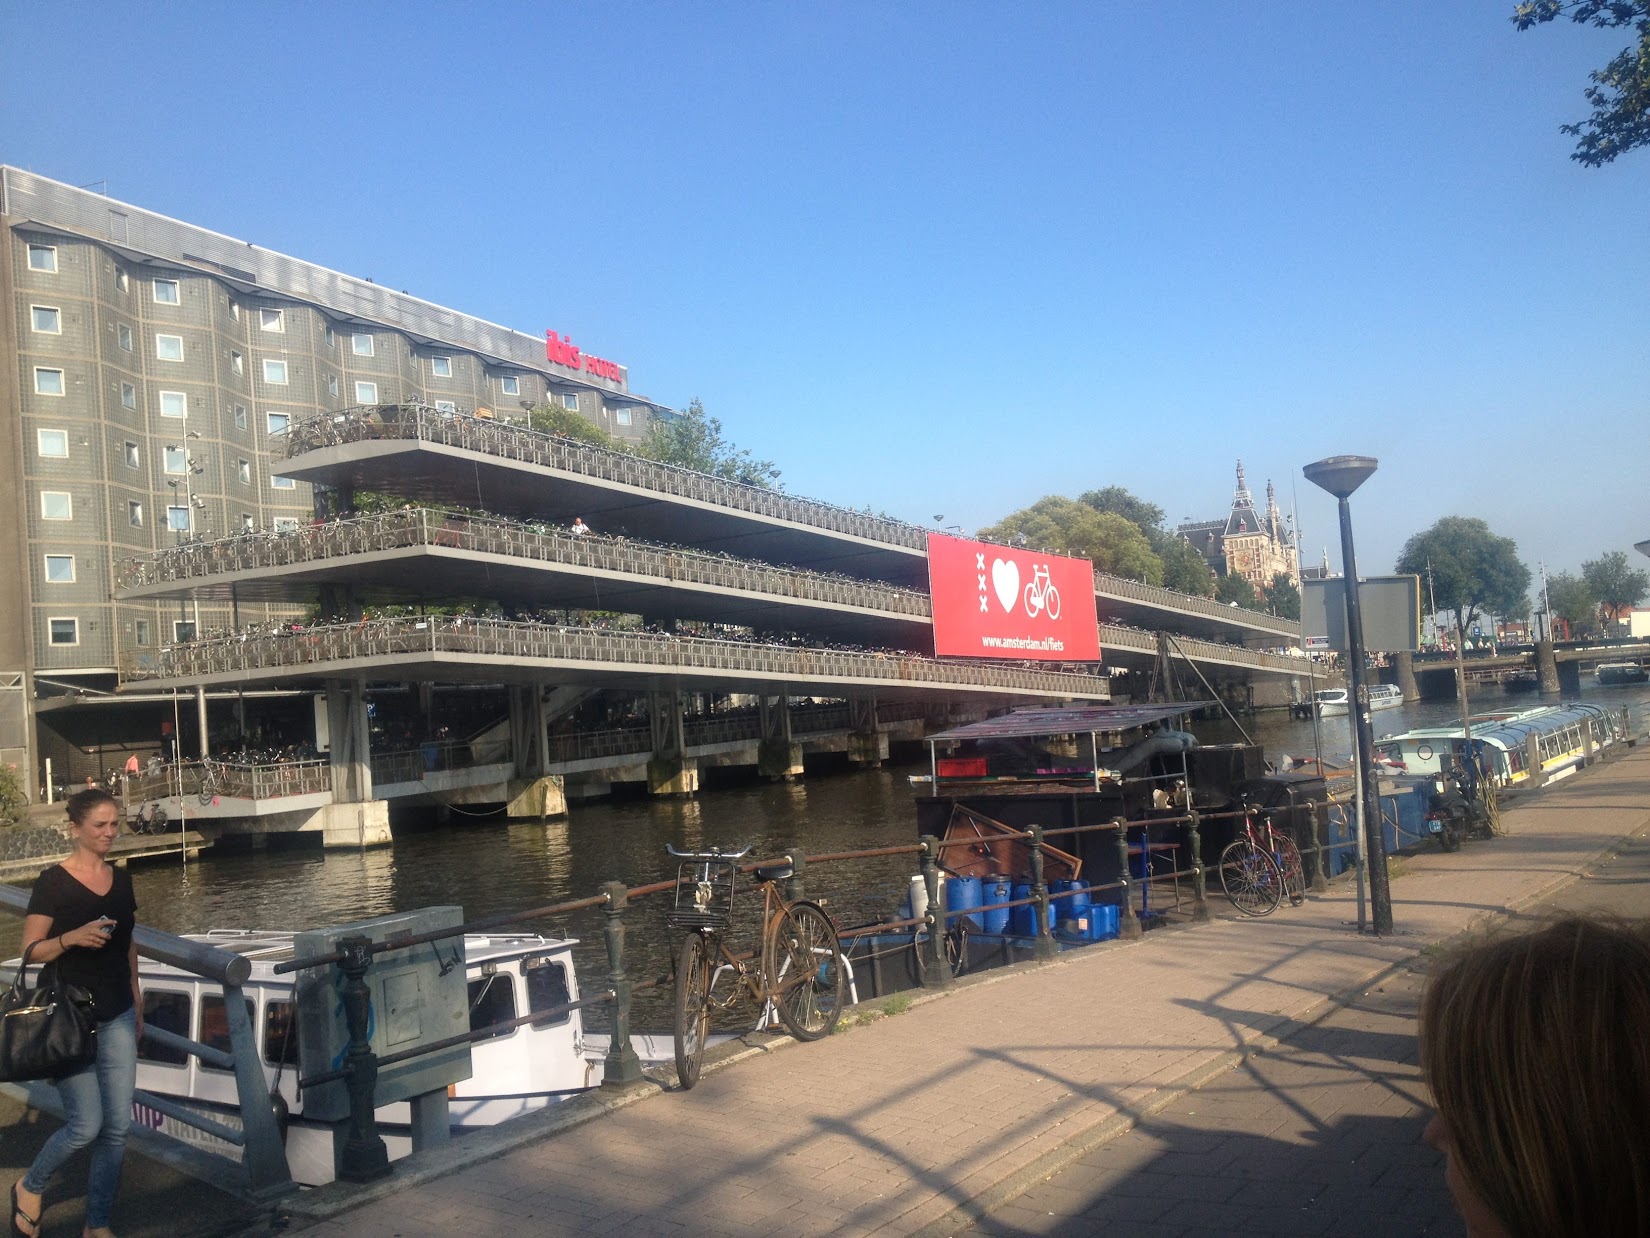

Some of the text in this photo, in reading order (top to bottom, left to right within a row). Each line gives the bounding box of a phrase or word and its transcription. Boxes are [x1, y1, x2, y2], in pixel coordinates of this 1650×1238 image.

[546, 329, 622, 383] ibis HOTEL
[982, 635, 1064, 651] www.amsterdam.nl/fiets
